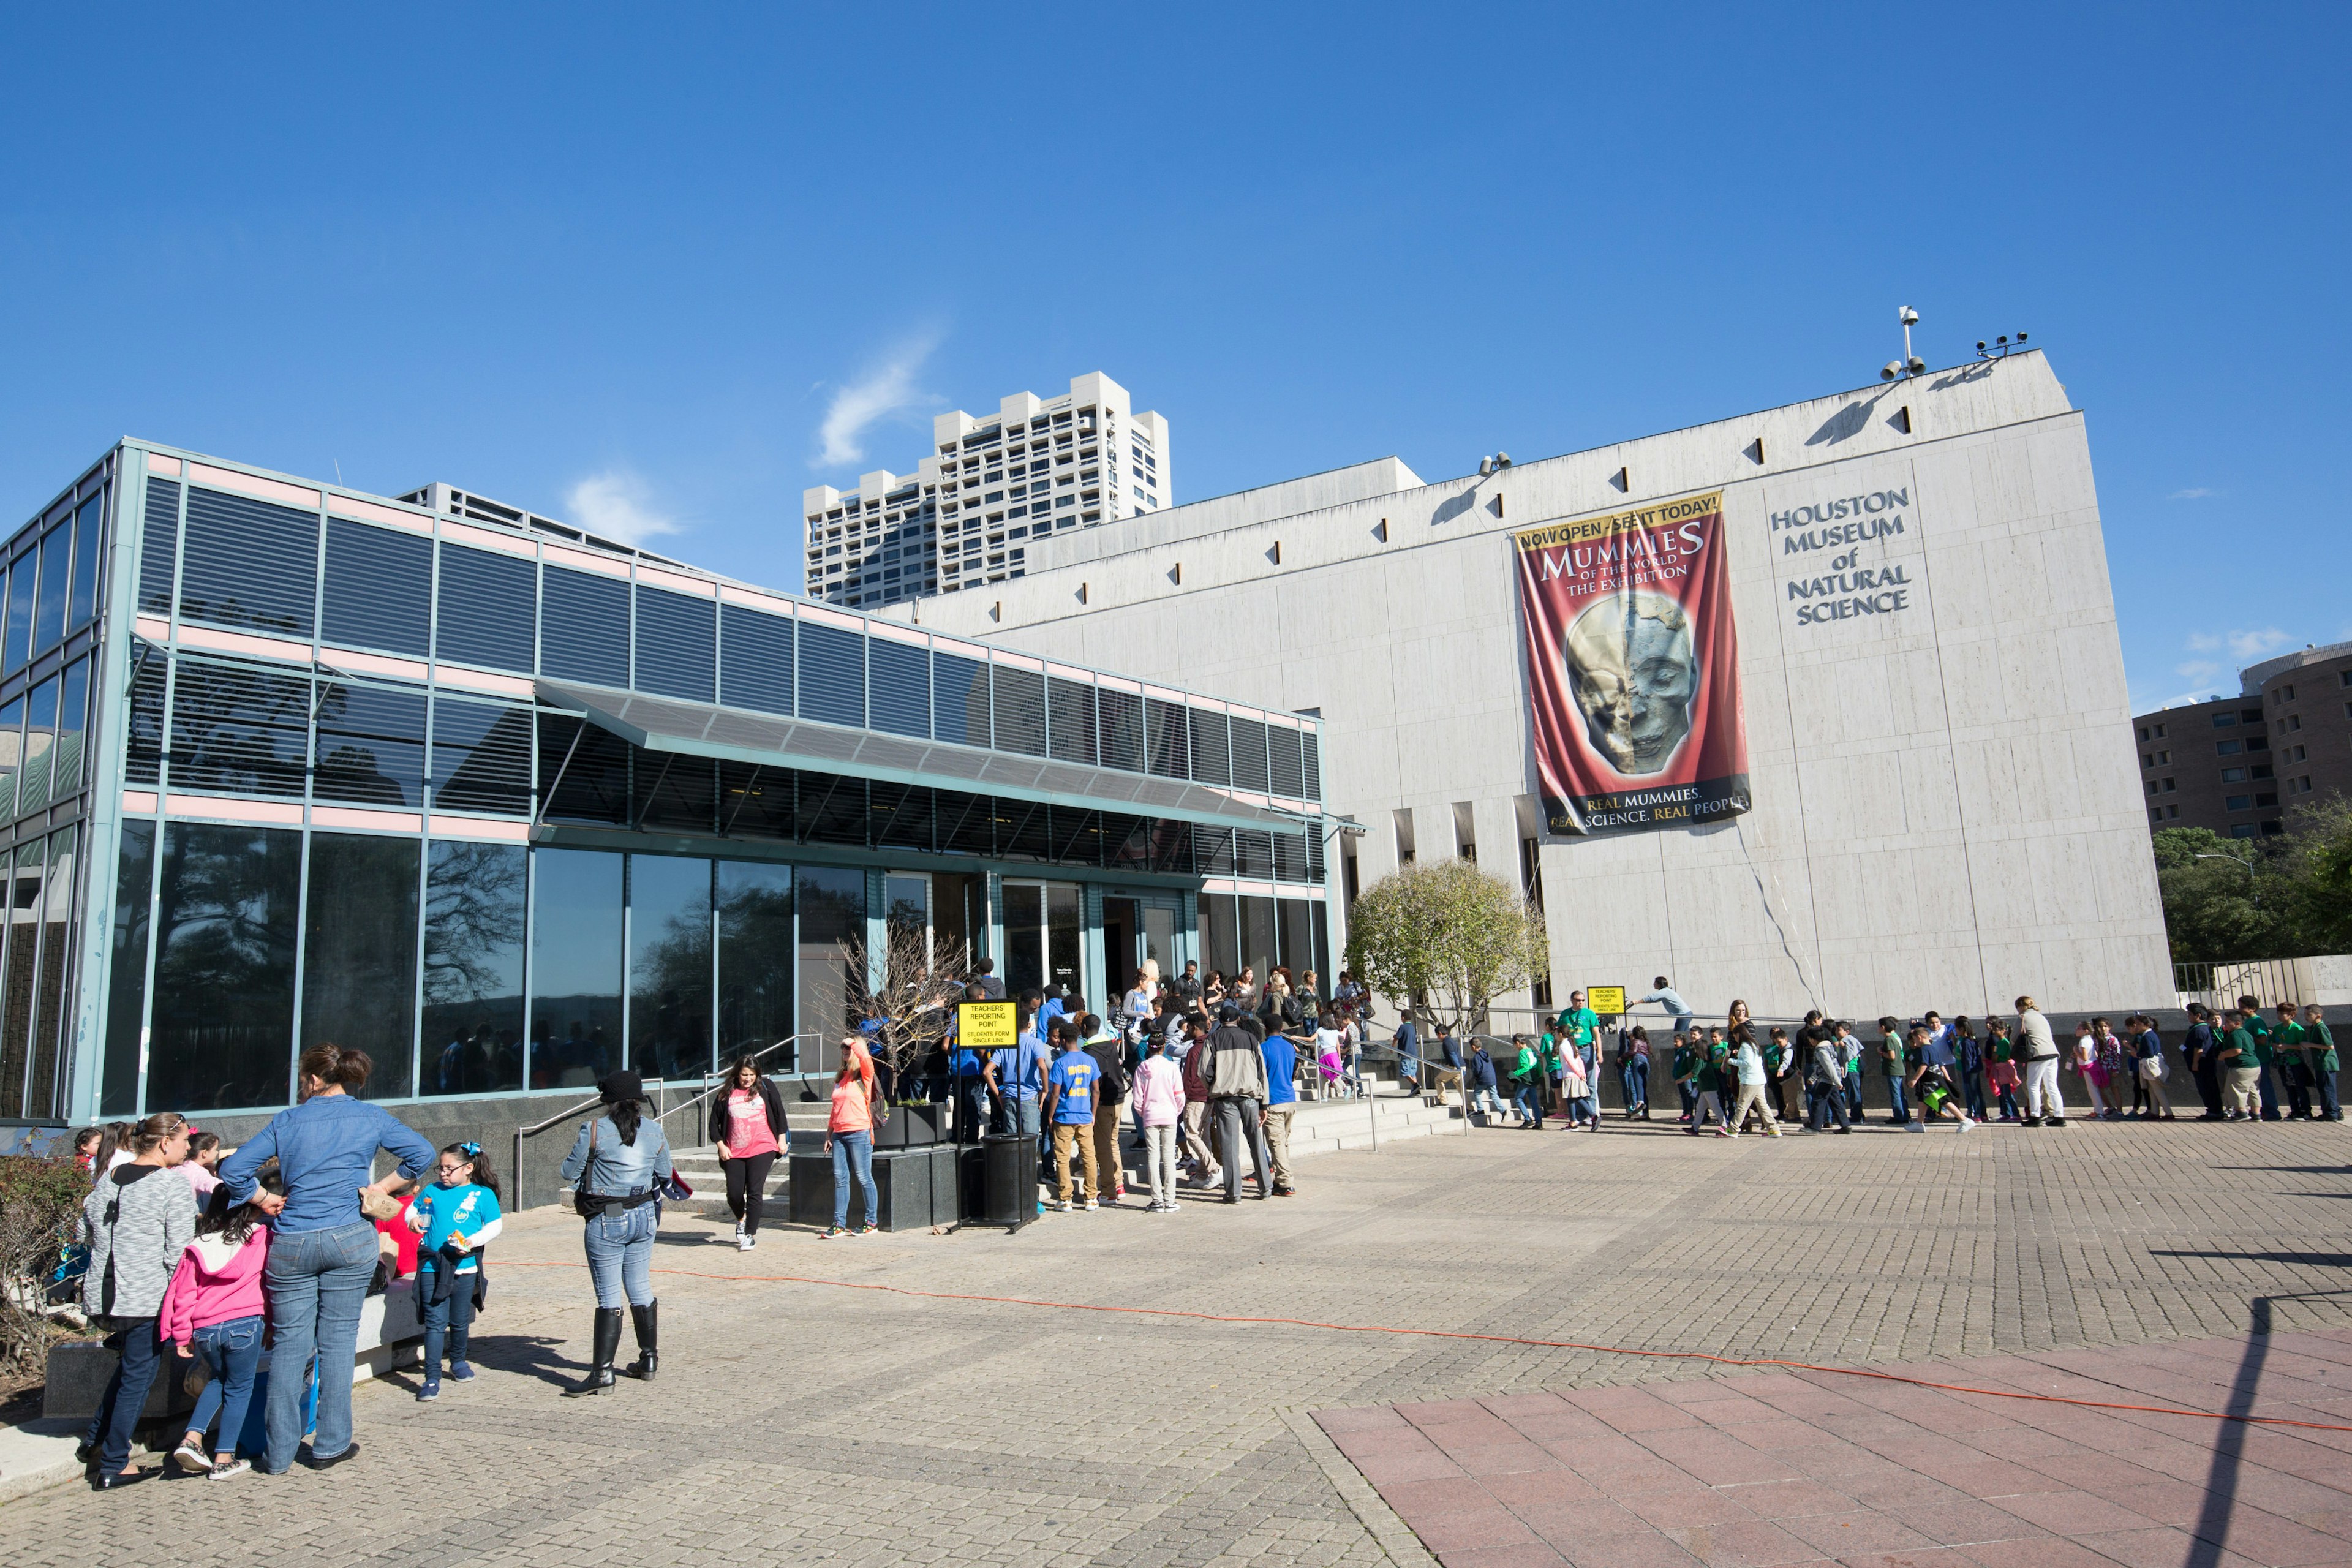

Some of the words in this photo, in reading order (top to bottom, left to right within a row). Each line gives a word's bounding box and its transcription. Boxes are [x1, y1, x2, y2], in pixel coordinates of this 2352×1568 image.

[1521, 532, 1556, 548] NOW
[1559, 522, 1602, 541] OPEN
[1613, 514, 1638, 530] SEE
[1642, 511, 1656, 526] IT
[1659, 497, 1717, 521] TODAY!
[1771, 487, 1909, 532] HOUSTON
[1540, 521, 1704, 581] MUMMIES
[1785, 514, 1905, 556] MUSEUM
[1580, 570, 1597, 580] OF
[1600, 560, 1626, 575] THE
[1630, 554, 1677, 570] WORLD
[1832, 546, 1858, 571] of
[1567, 579, 1596, 597] THE
[1601, 564, 1688, 591] EXHIBITION
[1788, 565, 1912, 601] NATURAL
[1796, 589, 1909, 626] SCIENCE
[1585, 810, 1650, 827] SCIENCE.
[1654, 805, 1691, 820] REAL
[1695, 796, 1749, 815] PEOPLE.
[1588, 797, 1621, 812] REAL
[1625, 788, 1702, 807] MUMMIES.
